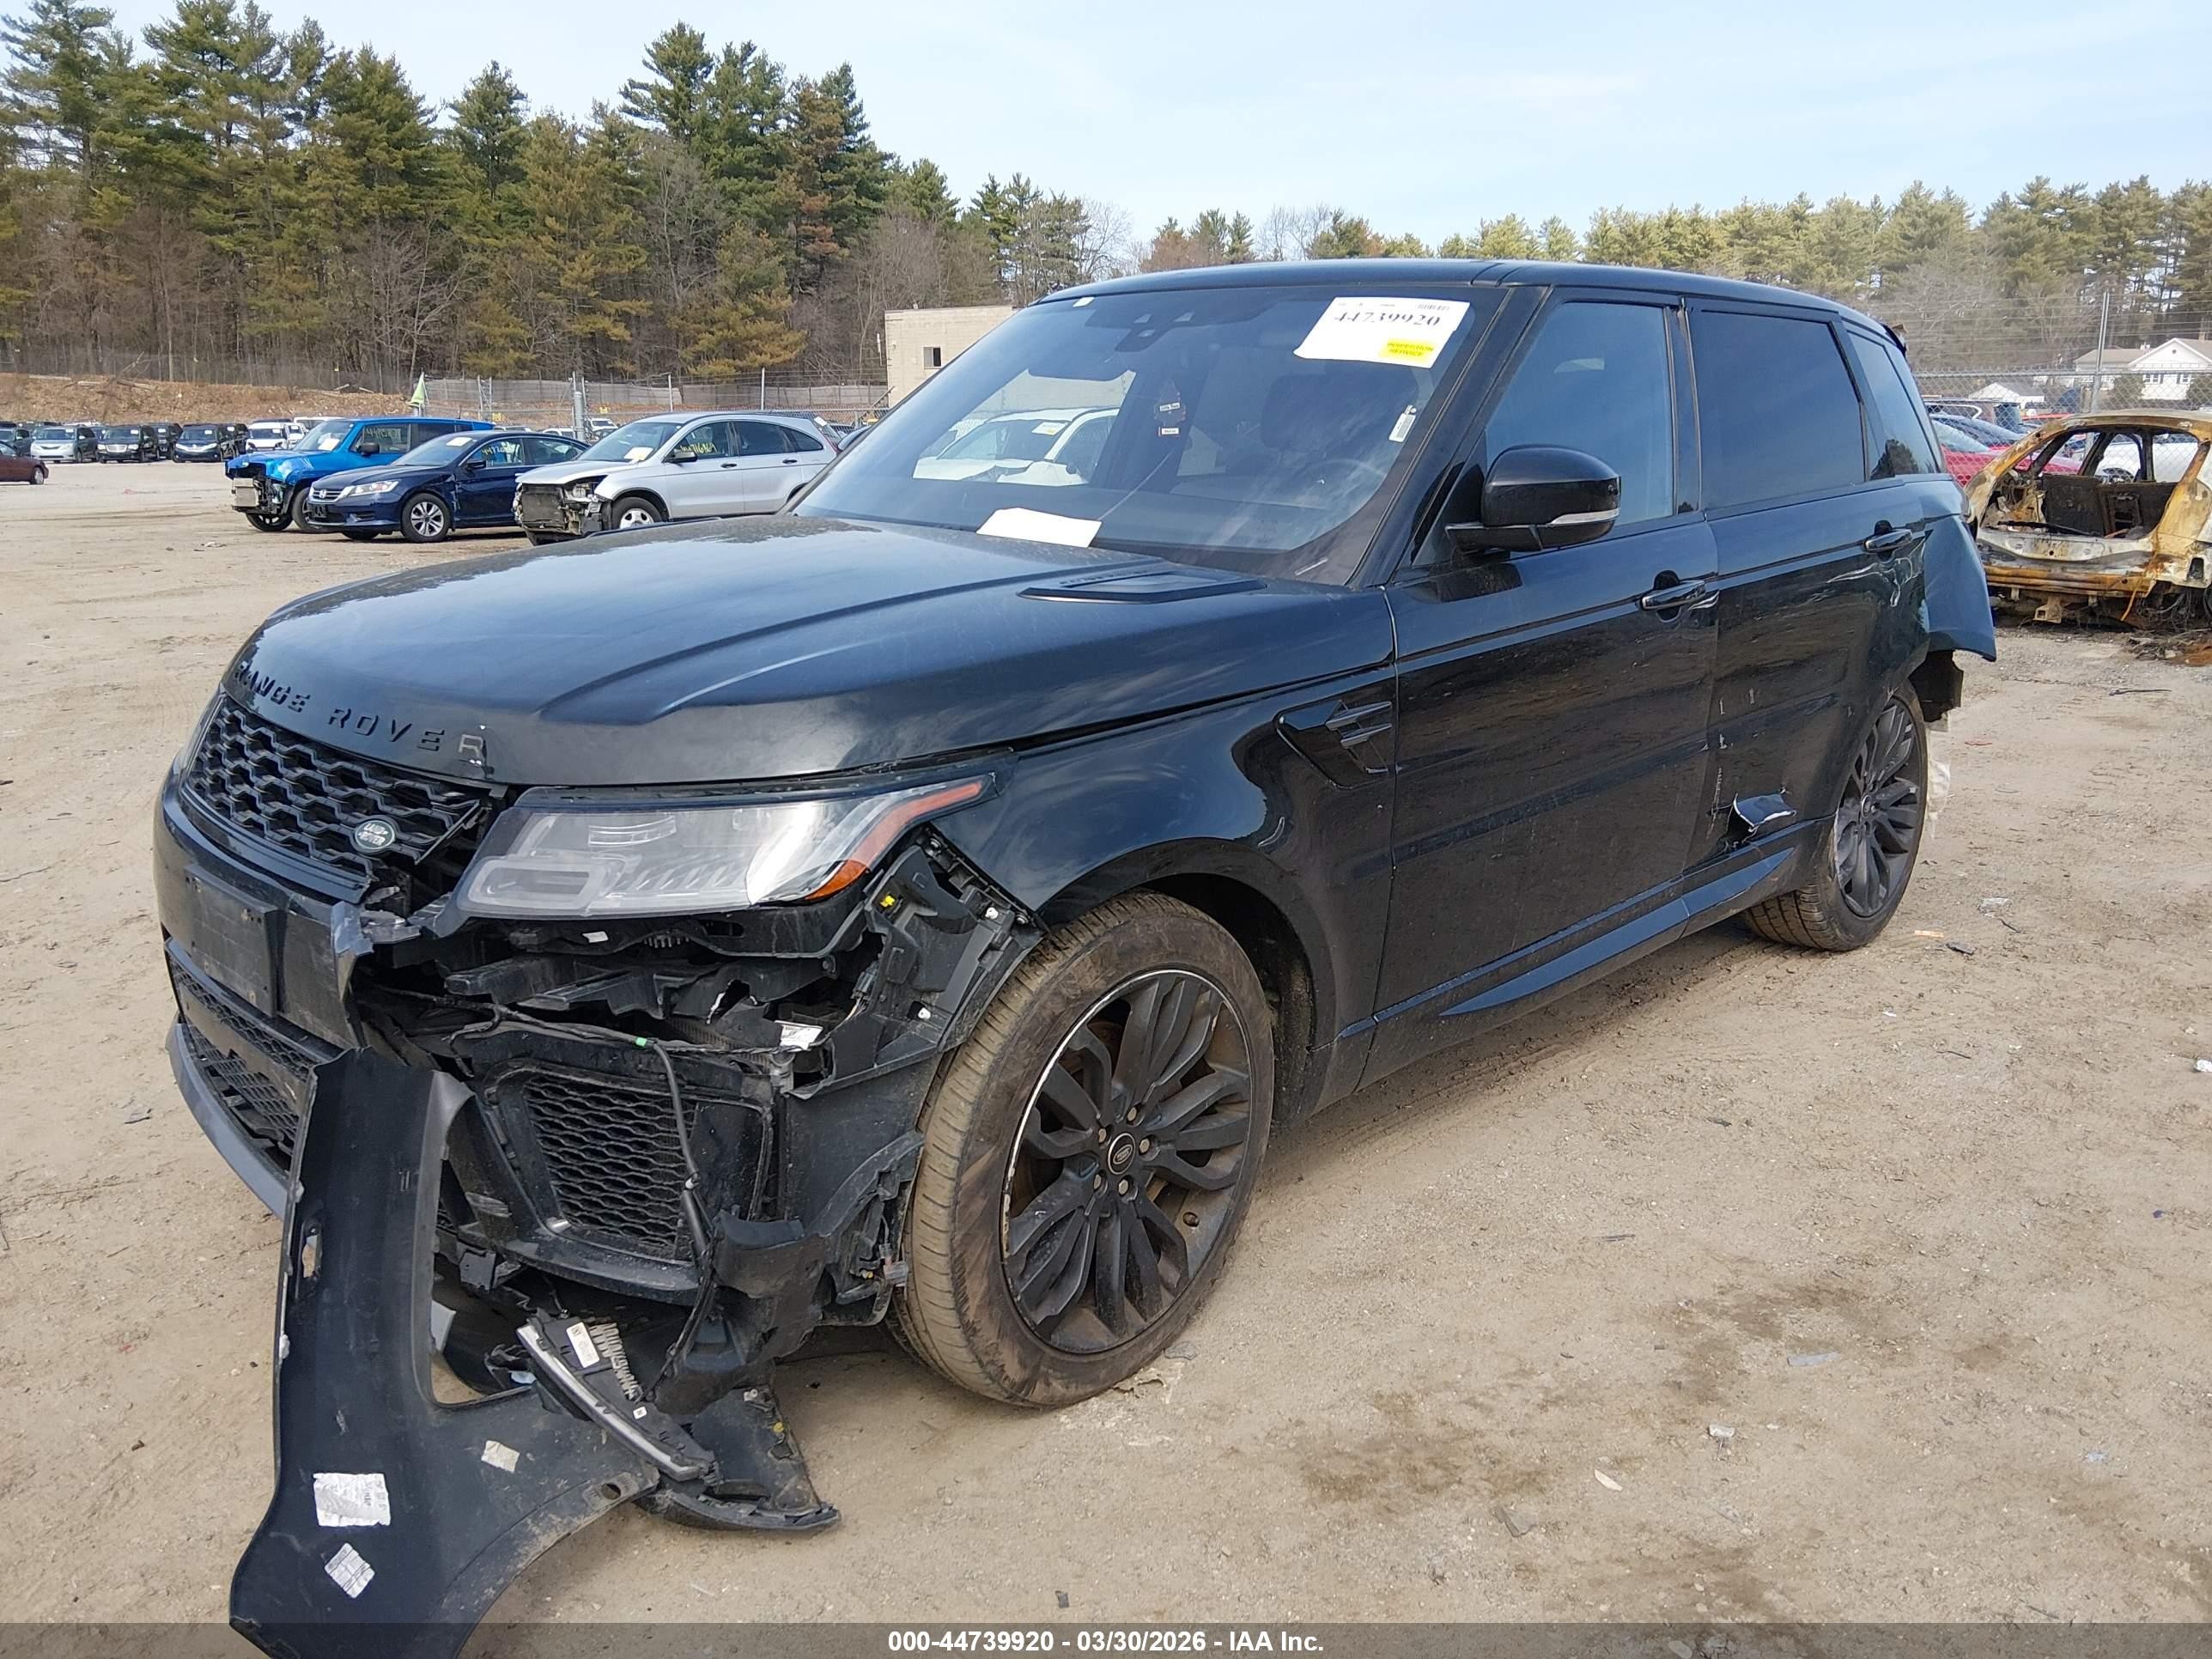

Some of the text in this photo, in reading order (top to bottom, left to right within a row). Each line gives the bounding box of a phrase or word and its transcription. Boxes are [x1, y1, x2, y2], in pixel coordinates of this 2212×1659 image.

[1334, 311, 1441, 326] 44739920
[234, 659, 487, 762] RANGE ROVER
